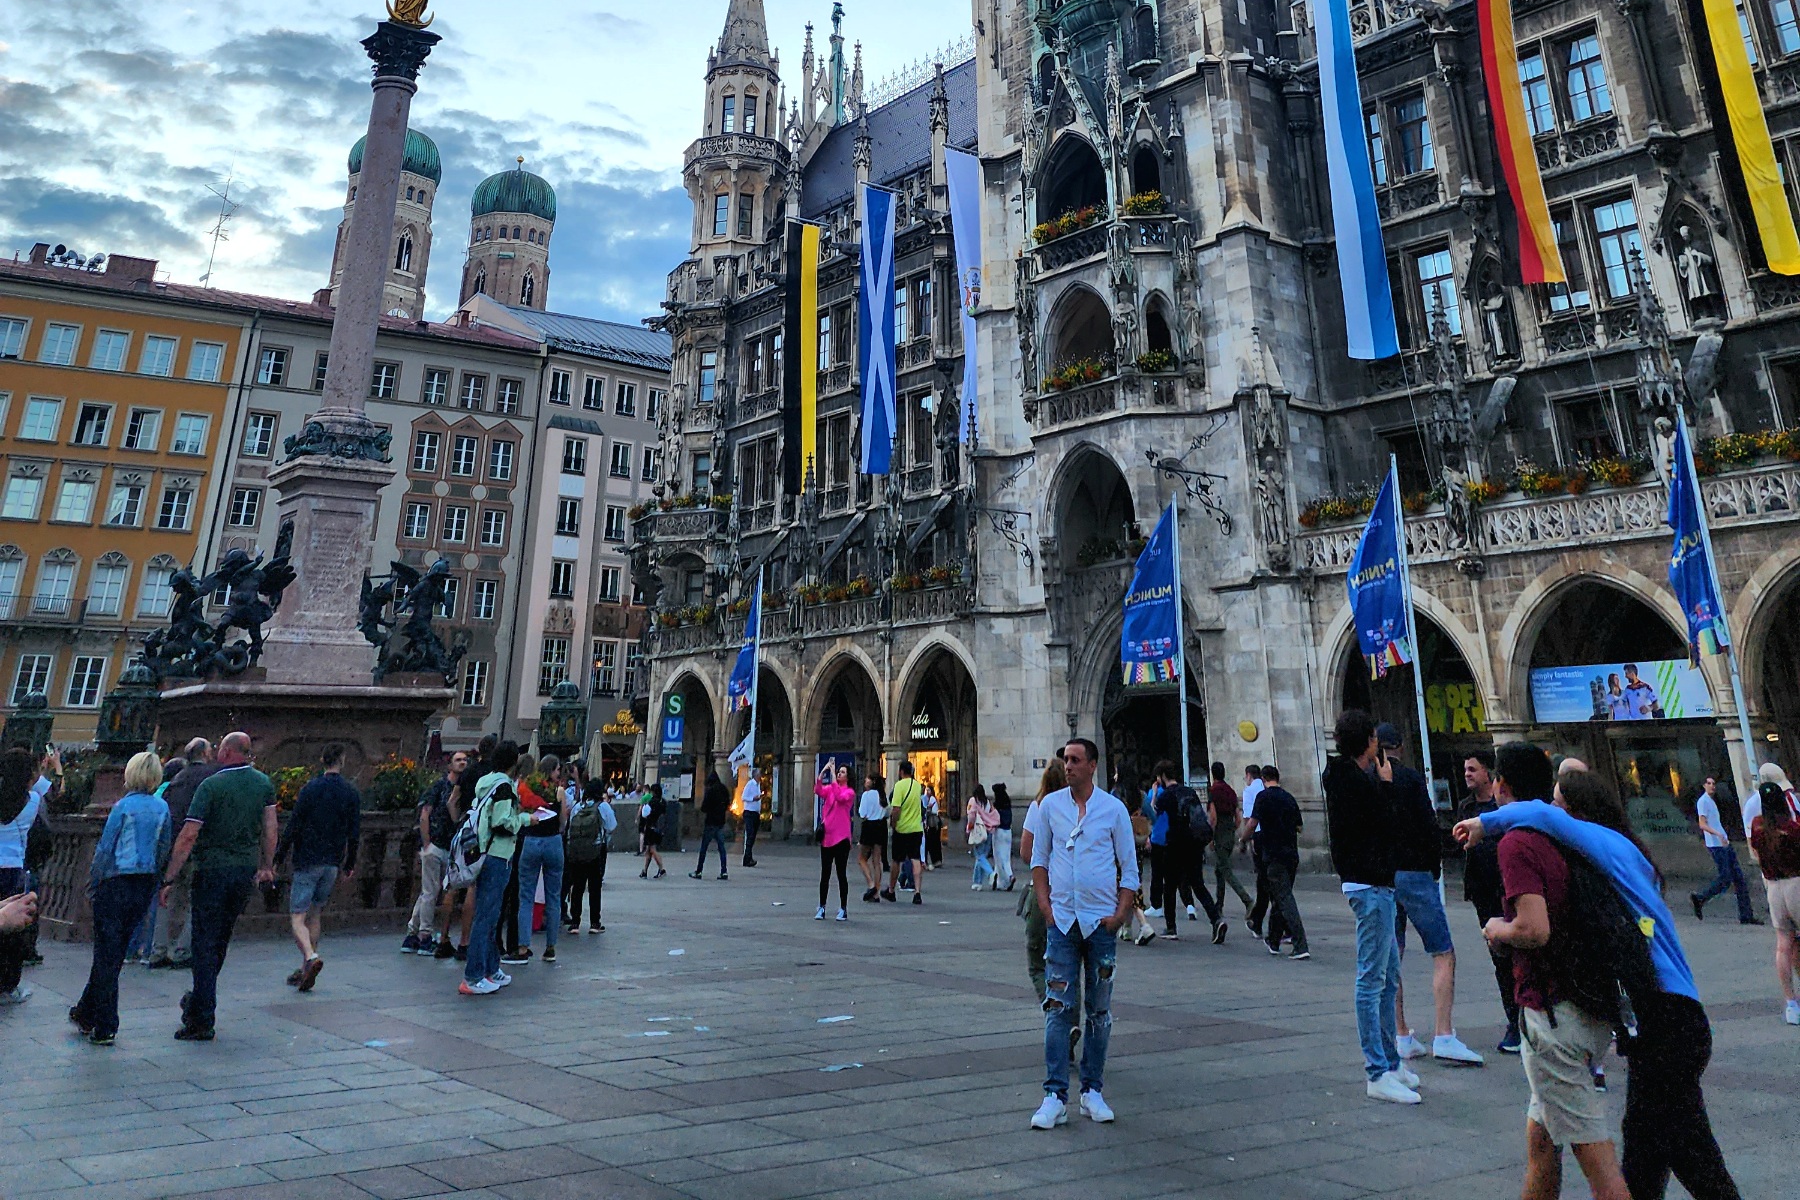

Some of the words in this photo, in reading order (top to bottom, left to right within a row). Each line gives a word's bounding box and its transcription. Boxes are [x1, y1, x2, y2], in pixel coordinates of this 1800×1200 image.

[669, 695, 681, 714] S
[667, 720, 679, 739] U
[911, 727, 939, 739] HMUCK
